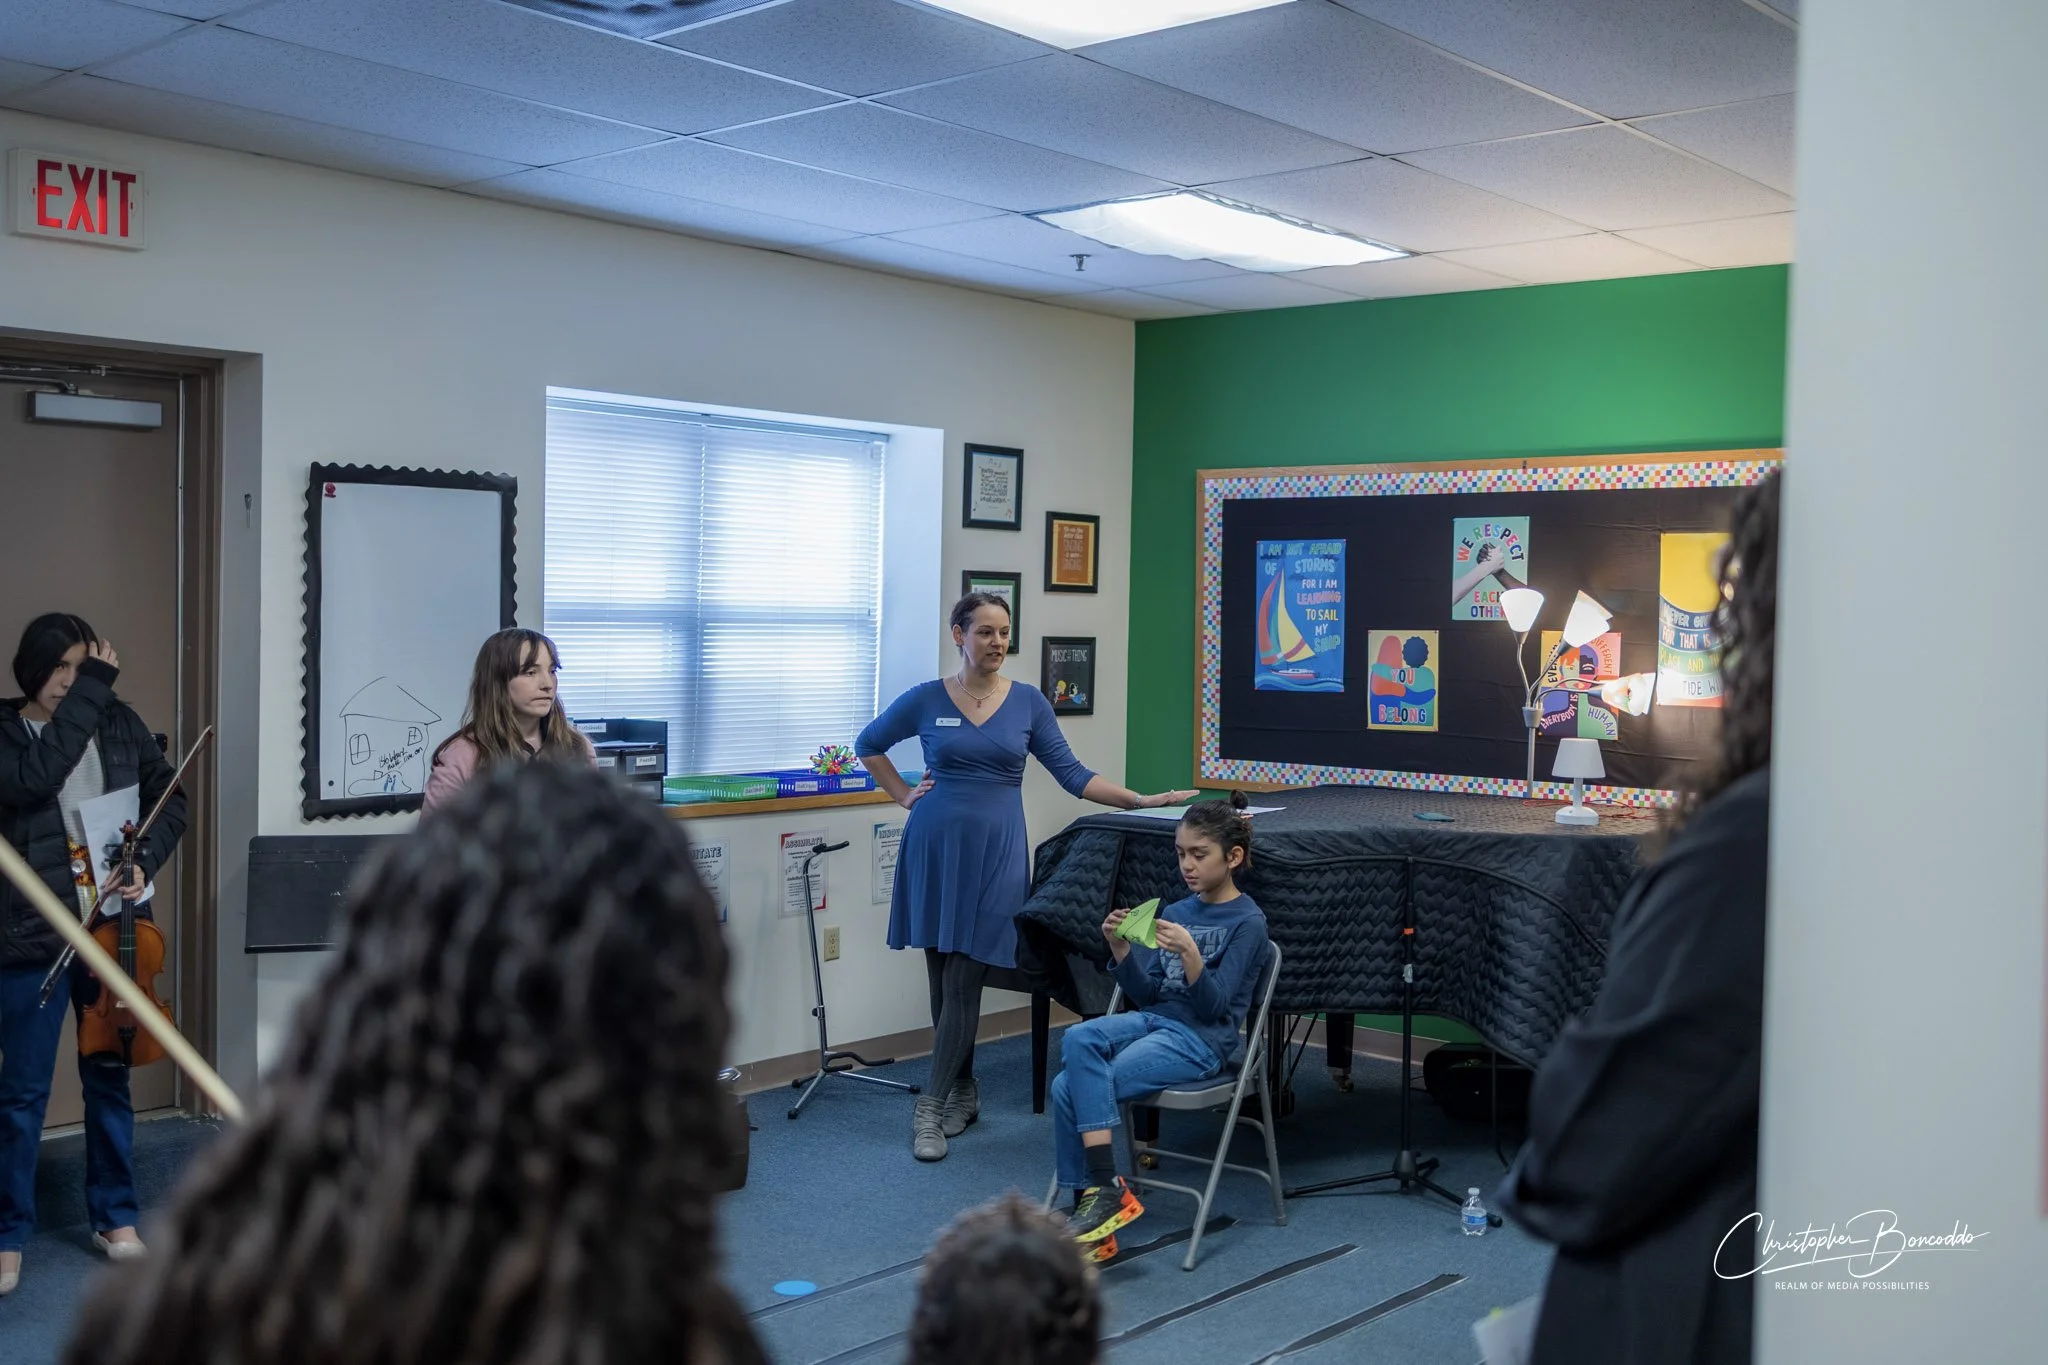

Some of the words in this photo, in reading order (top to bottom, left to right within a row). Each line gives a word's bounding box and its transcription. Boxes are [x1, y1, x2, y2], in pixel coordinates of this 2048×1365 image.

[37, 159, 137, 237] EXIT
[1260, 544, 1264, 556] I
[1268, 543, 1283, 556] AM
[1286, 542, 1305, 556] NOT
[1308, 542, 1343, 555] AFRAID
[1456, 536, 1475, 562] WE
[1473, 523, 1525, 561] RESPECT
[1264, 561, 1278, 576] OF
[1294, 558, 1336, 574] STORMS
[1302, 579, 1316, 589] FOR
[1319, 579, 1322, 589] I
[1325, 579, 1338, 589] AM
[1296, 590, 1342, 606] LEARNING
[1305, 608, 1317, 621] TO
[1318, 609, 1339, 621] SAIL
[1315, 623, 1329, 636] MY
[1314, 634, 1341, 653] SHIP
[1680, 631, 1699, 649] THAT
[1702, 633, 1712, 649] IS
[1051, 649, 1067, 662] MUSIC
[1687, 658, 1704, 672] AND
[1391, 668, 1415, 685] YOU
[1378, 704, 1427, 723] BELONG
[1541, 704, 1577, 730] EVERYBODY
[1570, 693, 1578, 702] IS
[1587, 707, 1616, 736] HUMAN
